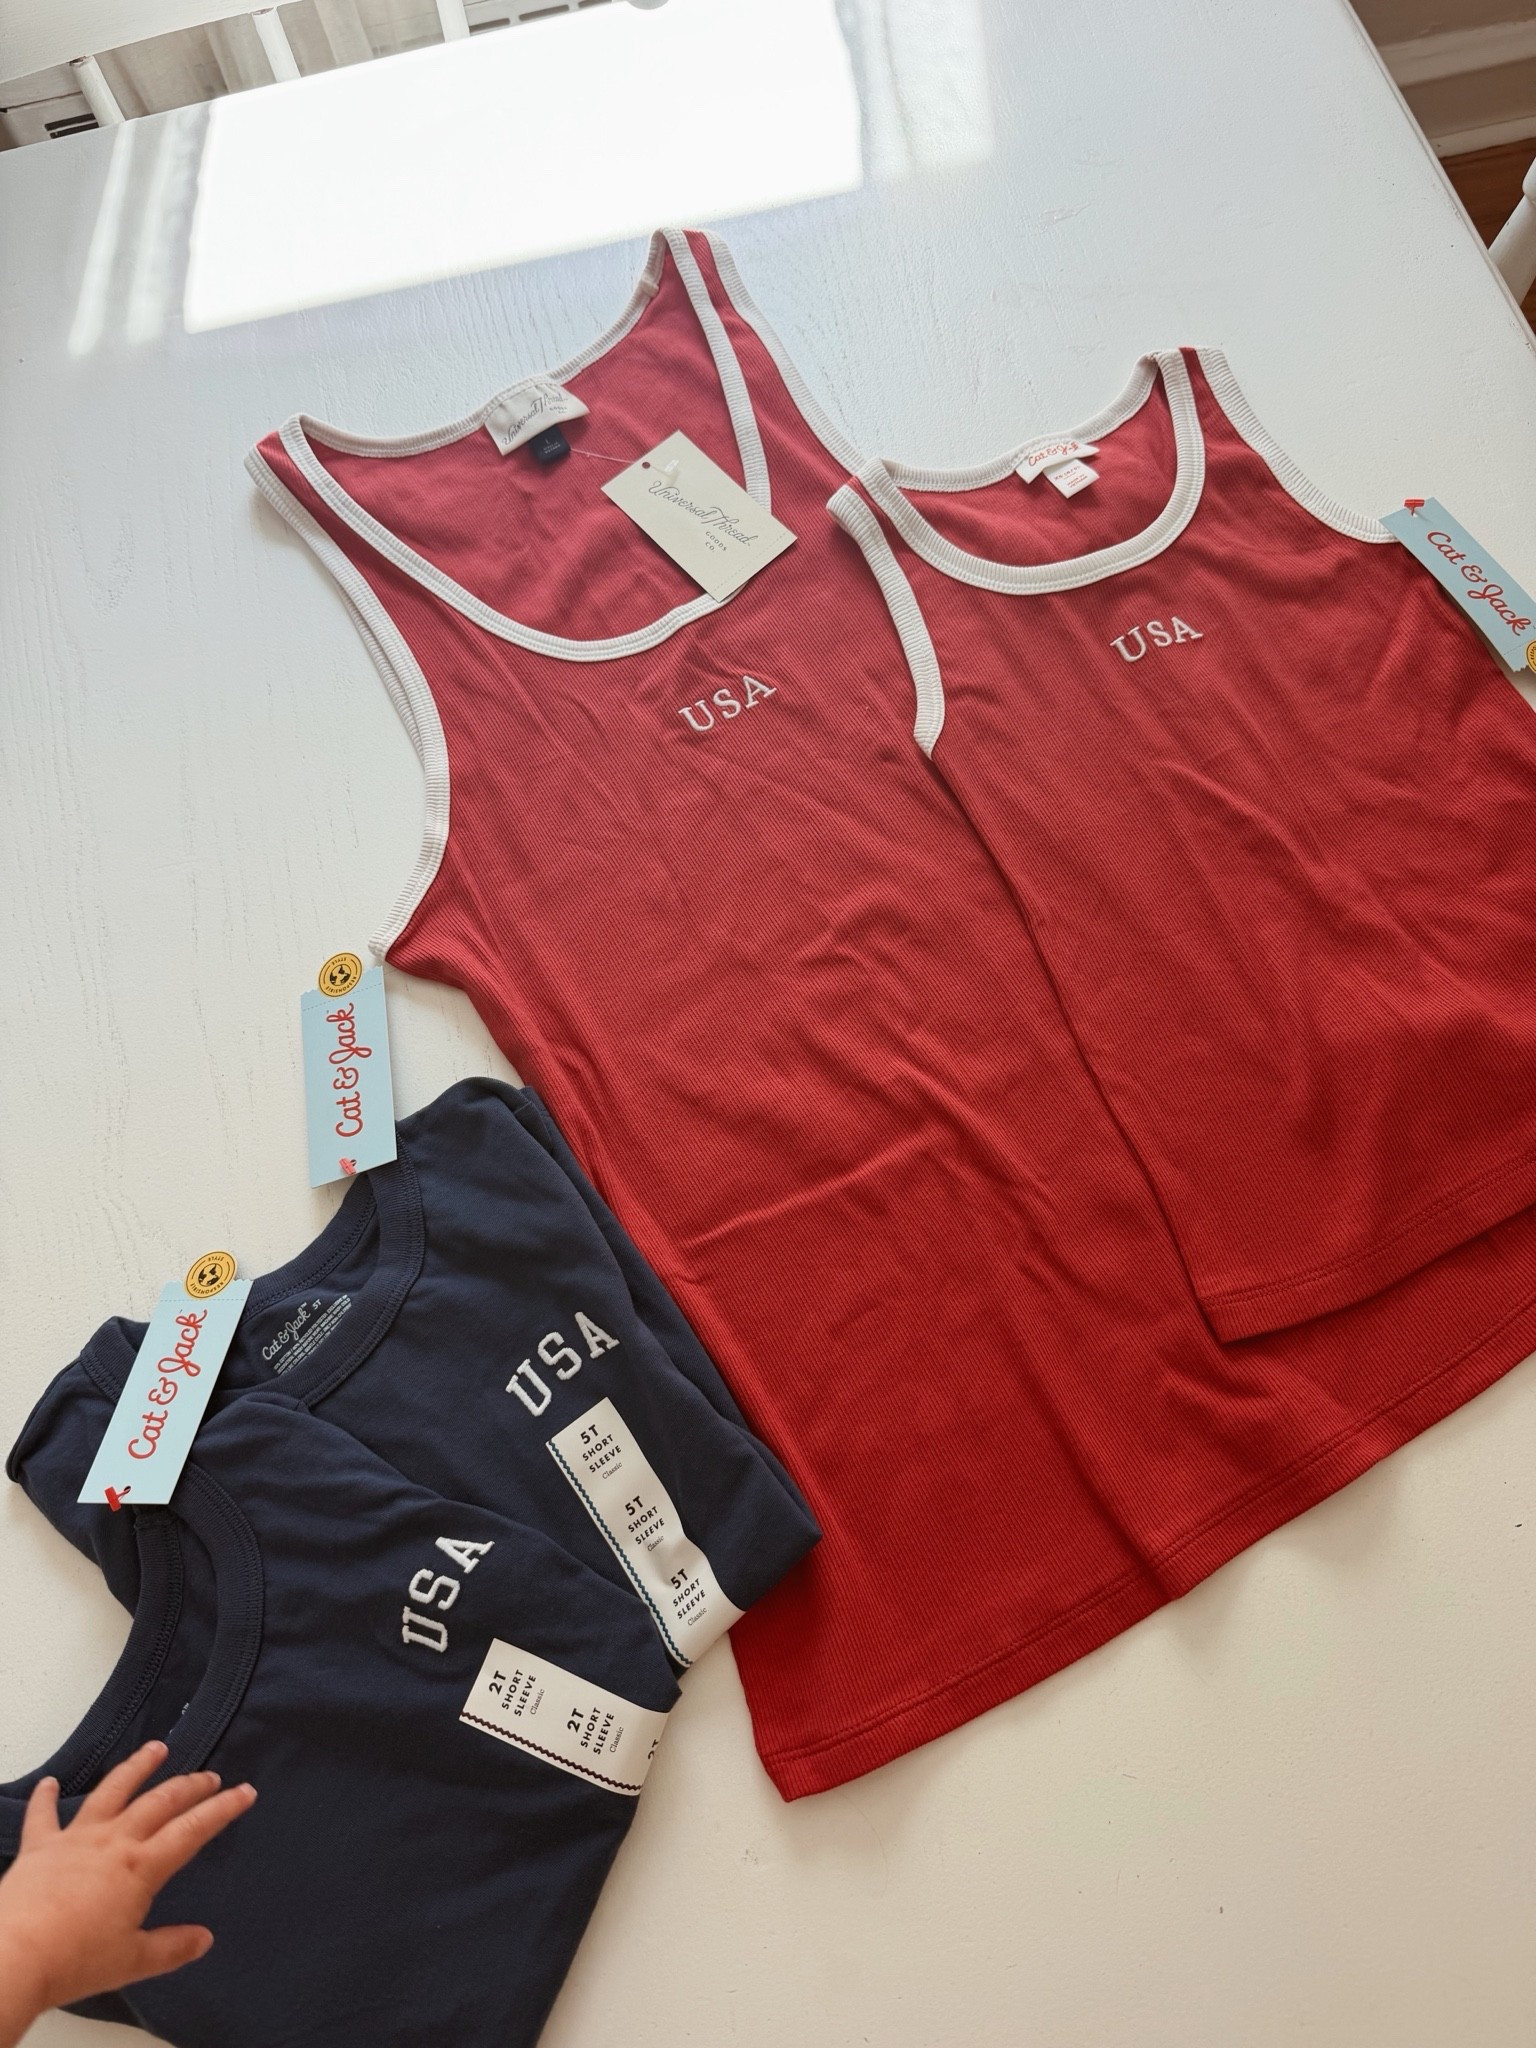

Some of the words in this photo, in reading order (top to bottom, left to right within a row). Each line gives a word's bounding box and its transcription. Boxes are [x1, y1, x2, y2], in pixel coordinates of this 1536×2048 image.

[648, 480, 717, 520] Universal
[701, 506, 759, 546] Thread
[705, 531, 728, 552] GOODS
[1426, 531, 1466, 565] Cat
[1460, 565, 1487, 583] &
[1467, 584, 1531, 636] Jack
[1110, 616, 1204, 662] USA
[678, 675, 777, 732] USA
[326, 1002, 373, 1065] Jack
[332, 1066, 360, 1090] &
[335, 1090, 364, 1138] Cat
[312, 1299, 322, 1310] 5T
[157, 1309, 208, 1377] Jack
[262, 1339, 282, 1360] Cat
[278, 1331, 290, 1343] &
[505, 1311, 620, 1417] USA
[148, 1376, 178, 1405] &
[127, 1410, 169, 1460] Cat
[580, 1424, 601, 1445] 5T
[582, 1433, 615, 1462] SHORT
[589, 1445, 622, 1473] SLEEVE
[601, 1461, 623, 1480] Classic
[624, 1495, 646, 1517] 5T
[627, 1505, 659, 1533] SHORT
[635, 1518, 666, 1545] SLEEVE
[647, 1533, 665, 1552] Classic
[670, 1568, 691, 1590] 5T
[672, 1577, 702, 1607] SHORT
[401, 1536, 496, 1653] USA
[677, 1589, 707, 1620] SLEEVE
[687, 1607, 708, 1627] Classic
[488, 1669, 507, 1696] 2T
[501, 1669, 524, 1711] SHORT
[514, 1674, 537, 1717] SLEEVE
[529, 1688, 546, 1716] Classic
[566, 1707, 585, 1733] 2T
[580, 1706, 602, 1749] SHORT
[593, 1712, 615, 1755] SLEEVE
[609, 1726, 625, 1753] Classic
